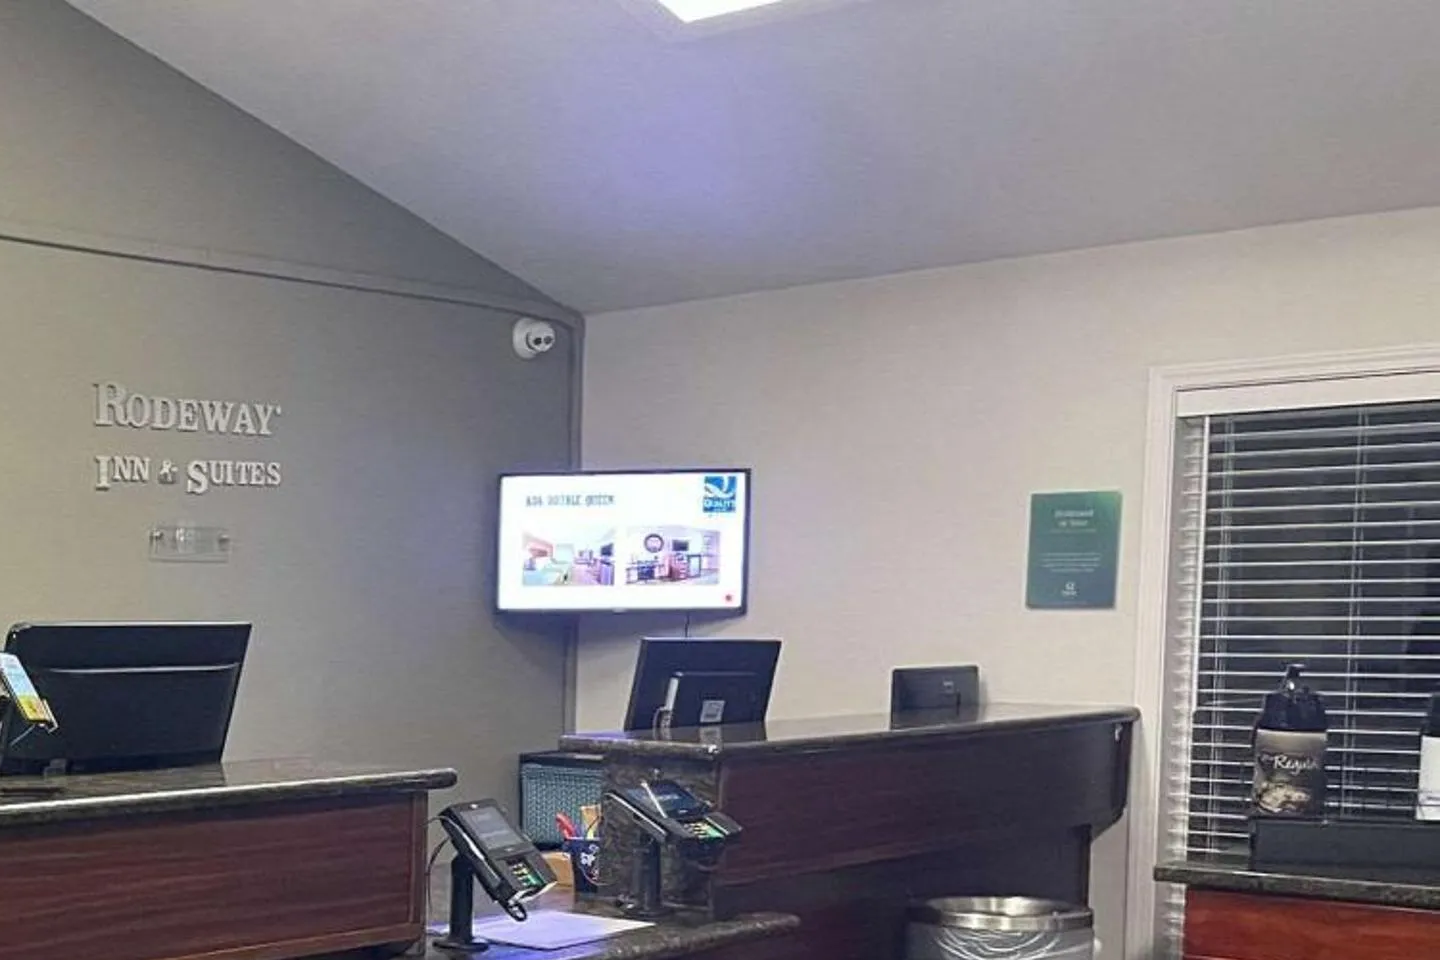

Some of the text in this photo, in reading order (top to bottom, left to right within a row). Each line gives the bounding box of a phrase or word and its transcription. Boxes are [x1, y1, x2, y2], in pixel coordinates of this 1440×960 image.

[92, 381, 274, 435] RODEWAY
[94, 454, 281, 495] INN & SUITES
